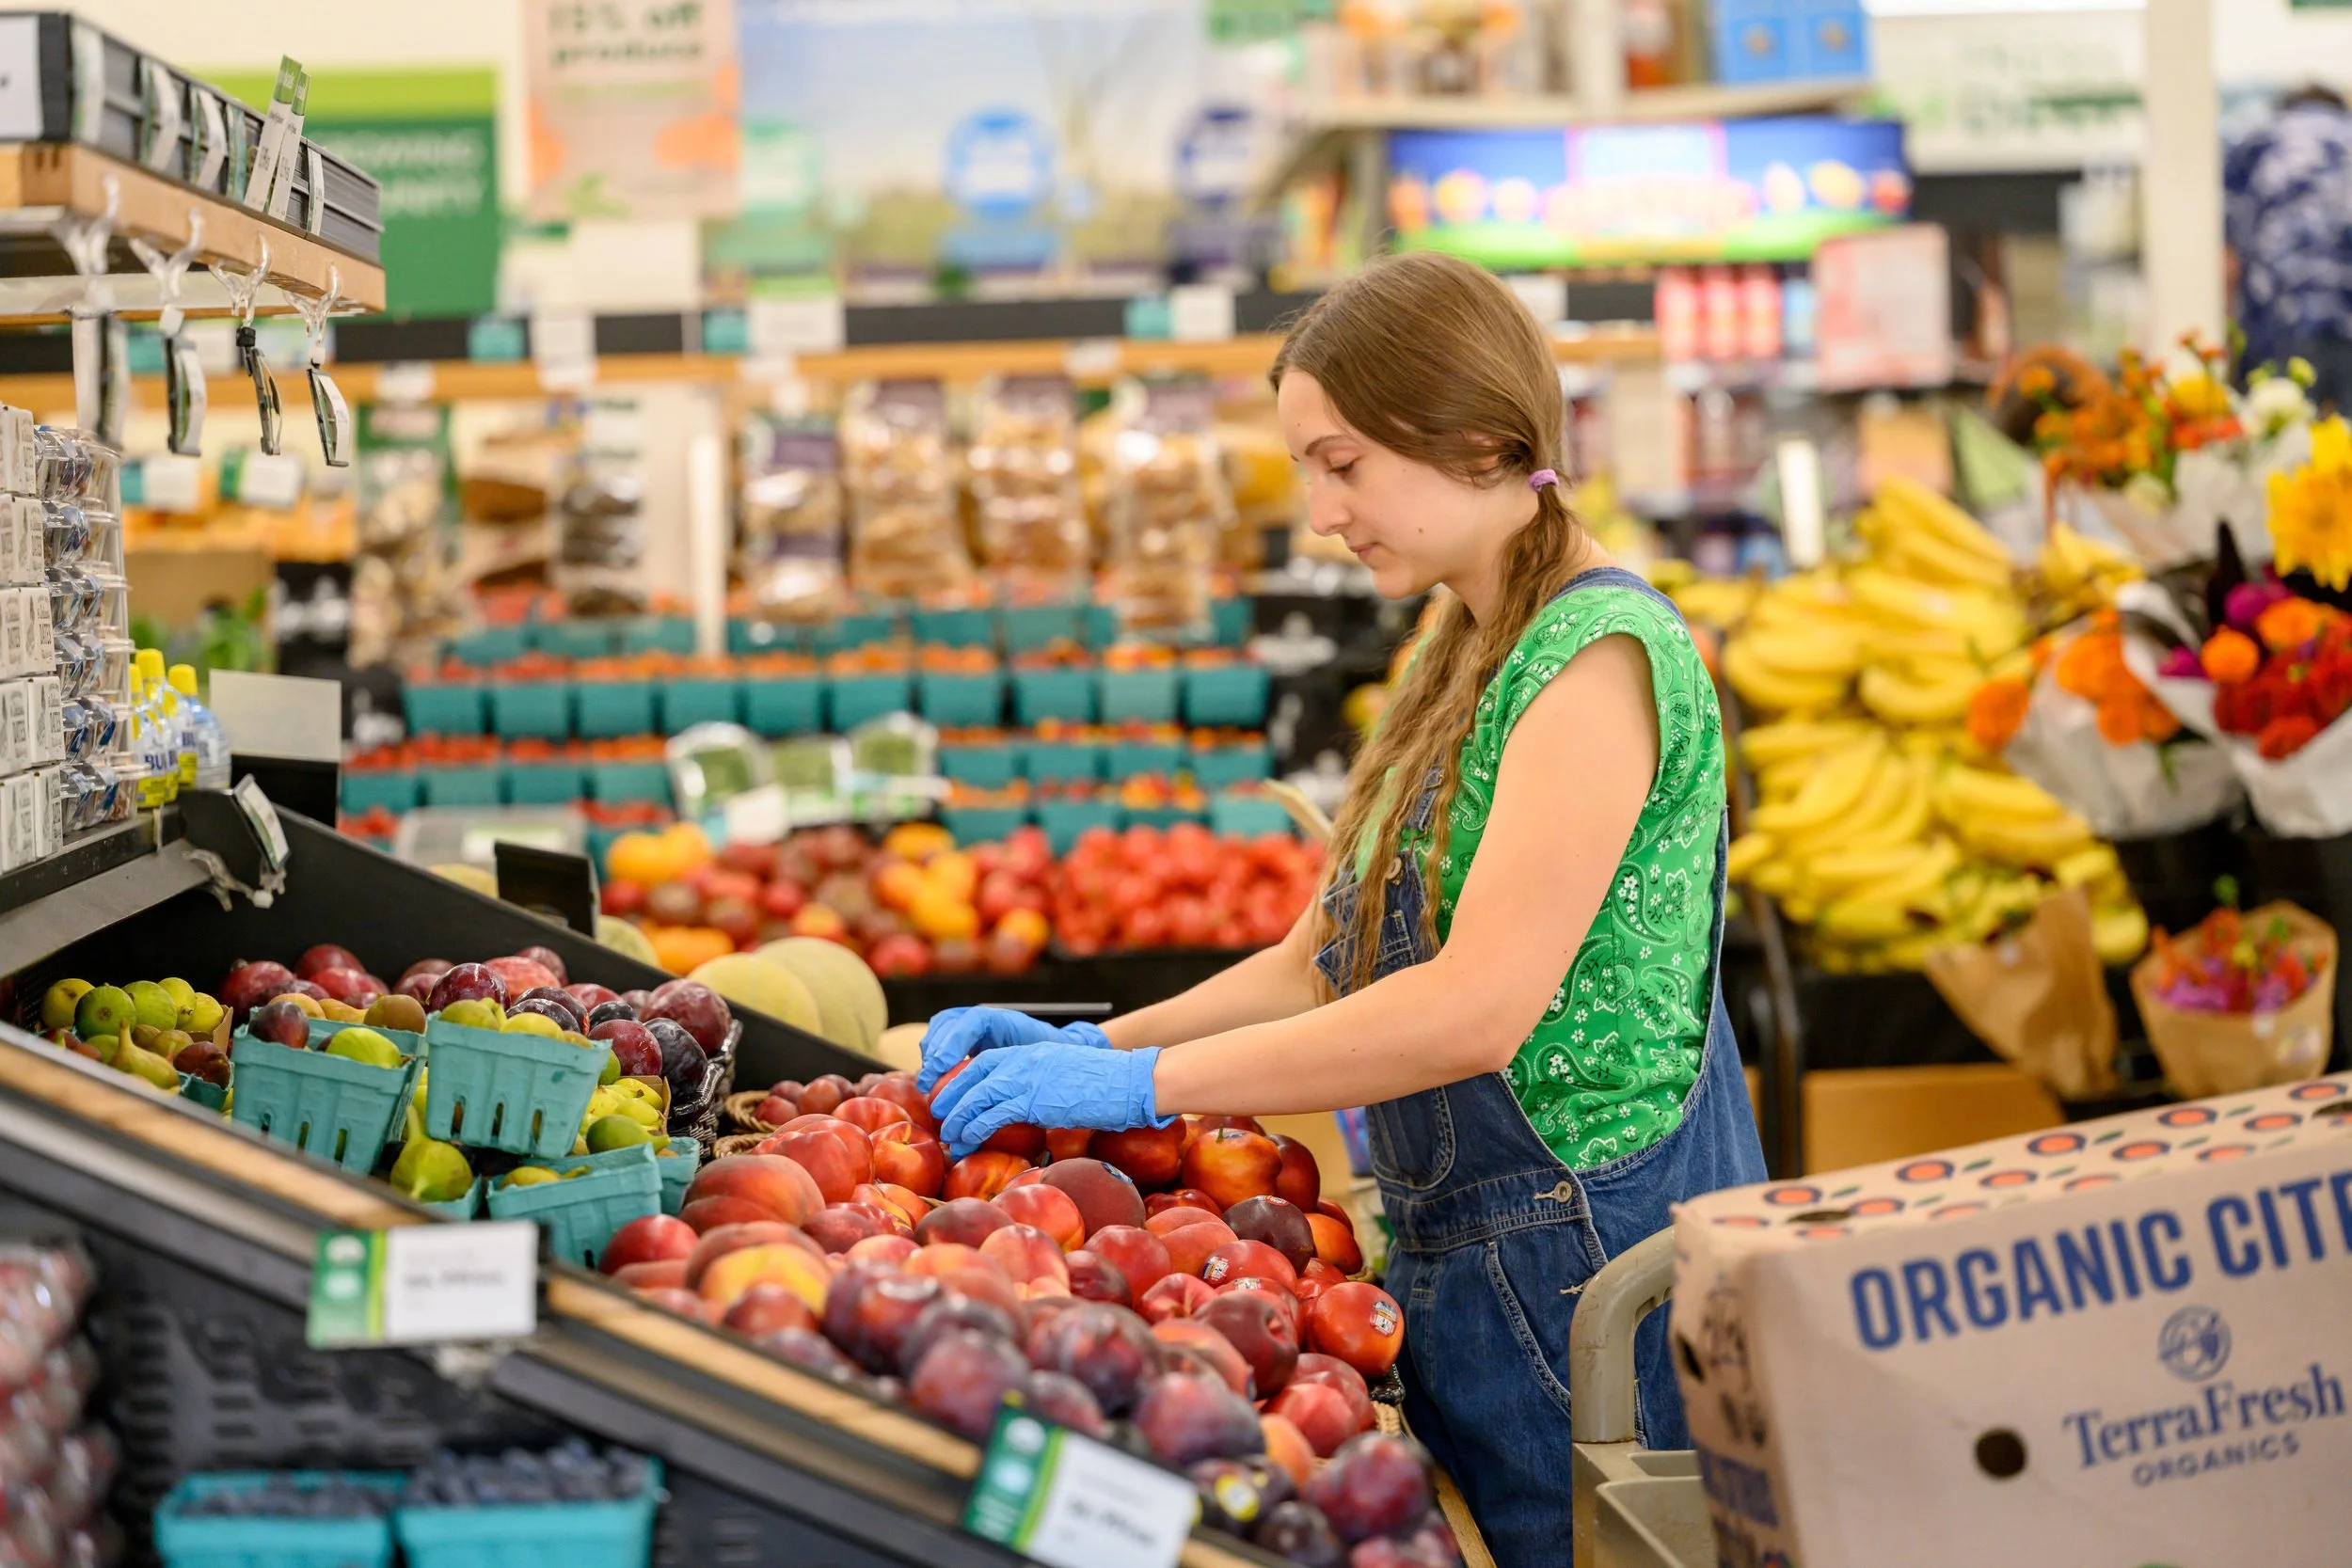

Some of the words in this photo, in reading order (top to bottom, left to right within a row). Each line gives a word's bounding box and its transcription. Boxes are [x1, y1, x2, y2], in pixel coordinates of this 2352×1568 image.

[1850, 1211, 2193, 1352] ORGANIC
[2063, 1363, 2345, 1469] TerraFresh
[2132, 1431, 2299, 1487] ORGANICS
